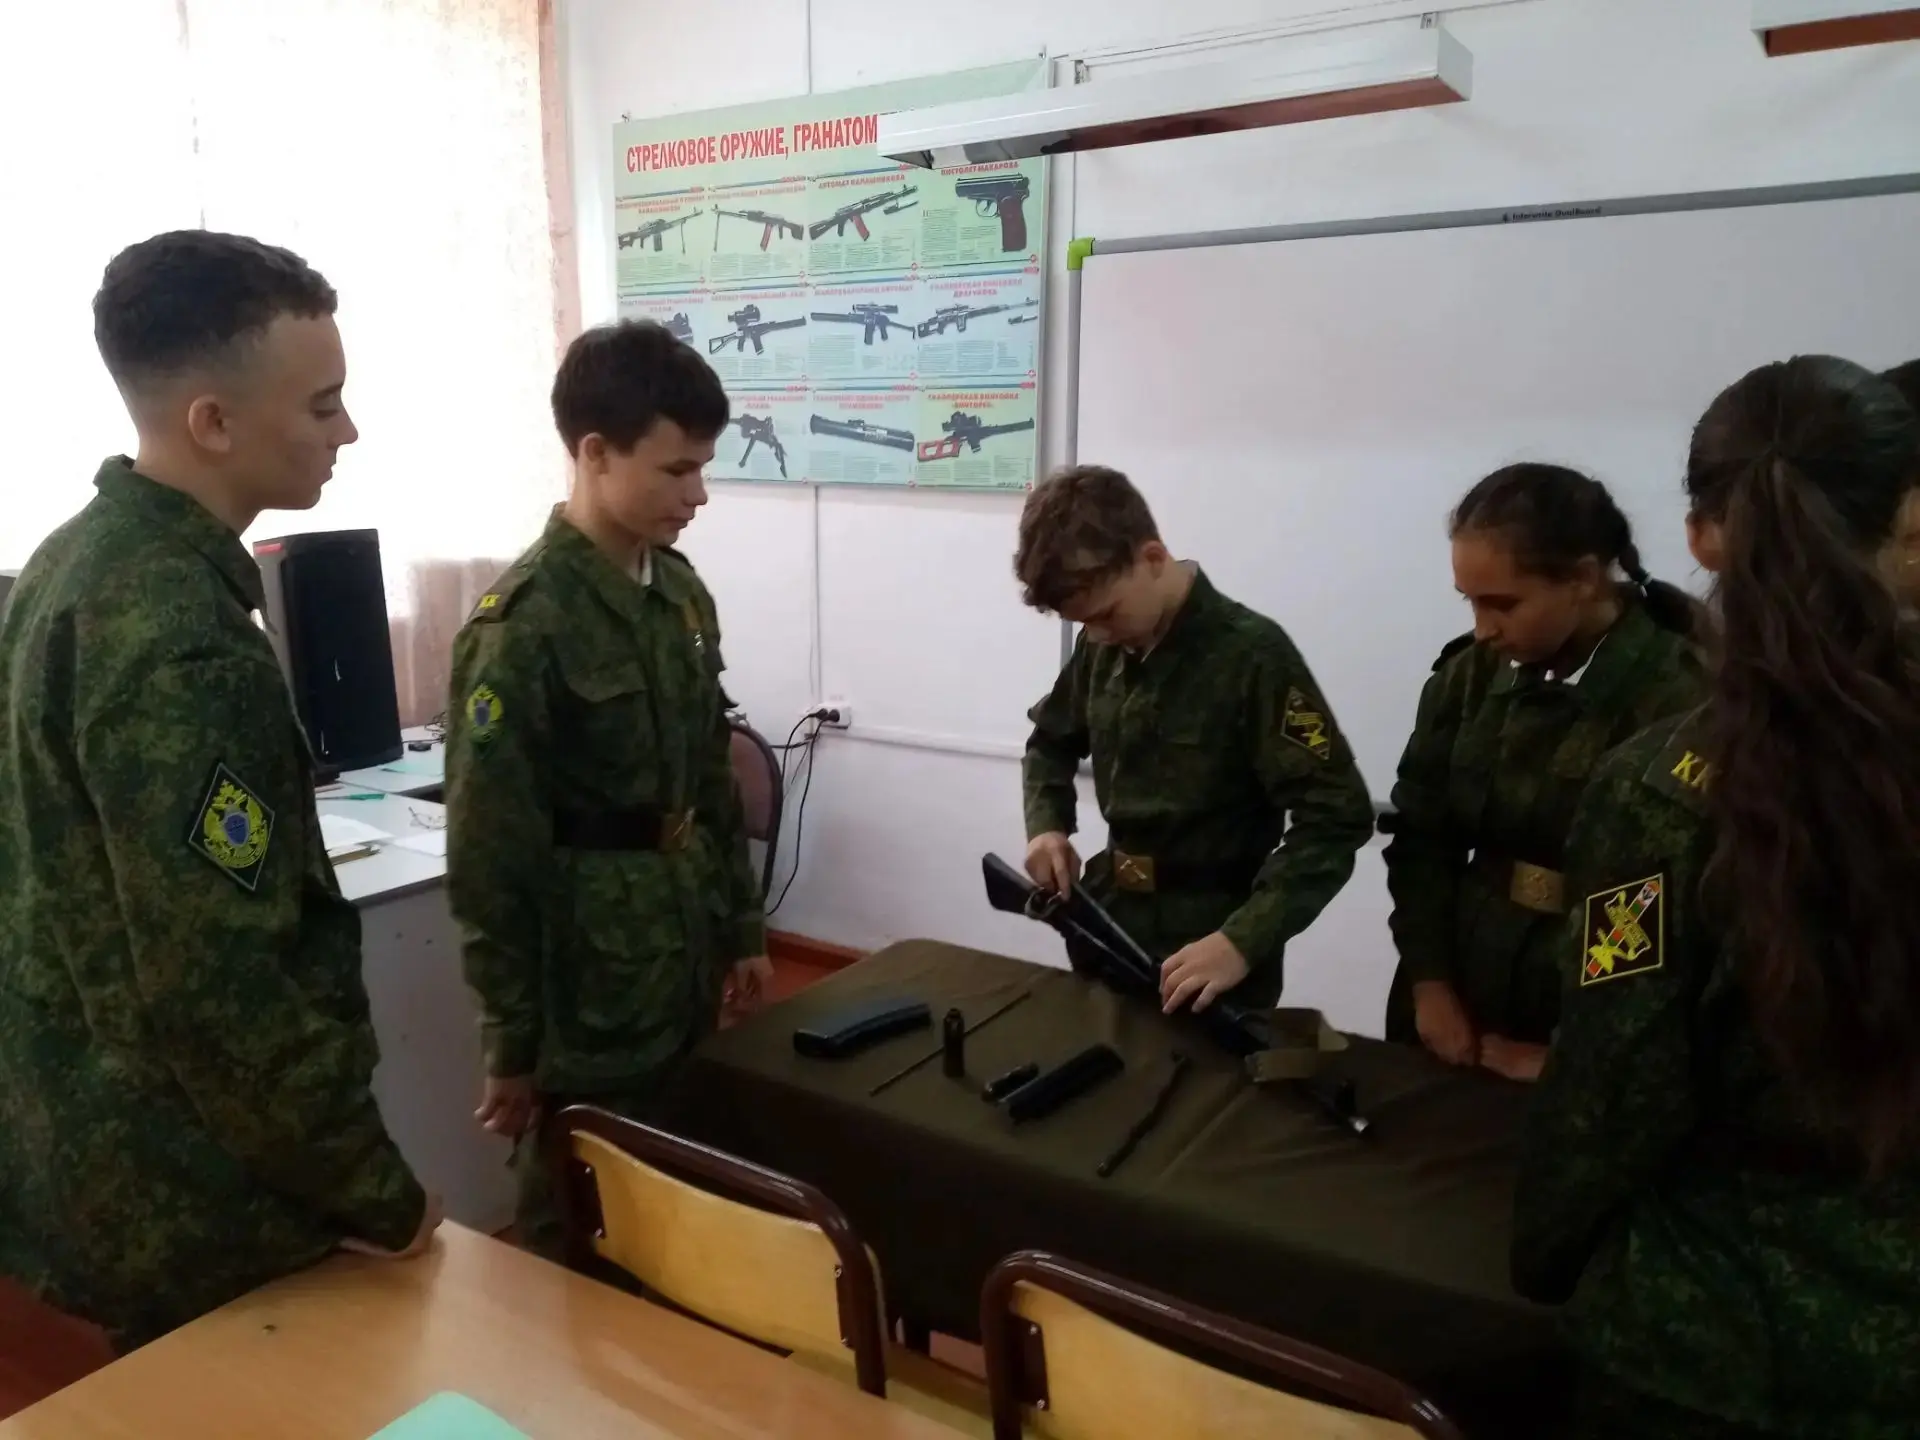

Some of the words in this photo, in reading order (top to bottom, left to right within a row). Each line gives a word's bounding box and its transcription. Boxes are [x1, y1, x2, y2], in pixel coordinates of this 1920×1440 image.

[626, 136, 717, 173] СТРЕЛКОВОЕ
[719, 125, 789, 161] ОРУЖИЕ,
[793, 112, 881, 152] ГРАНАТОМ
